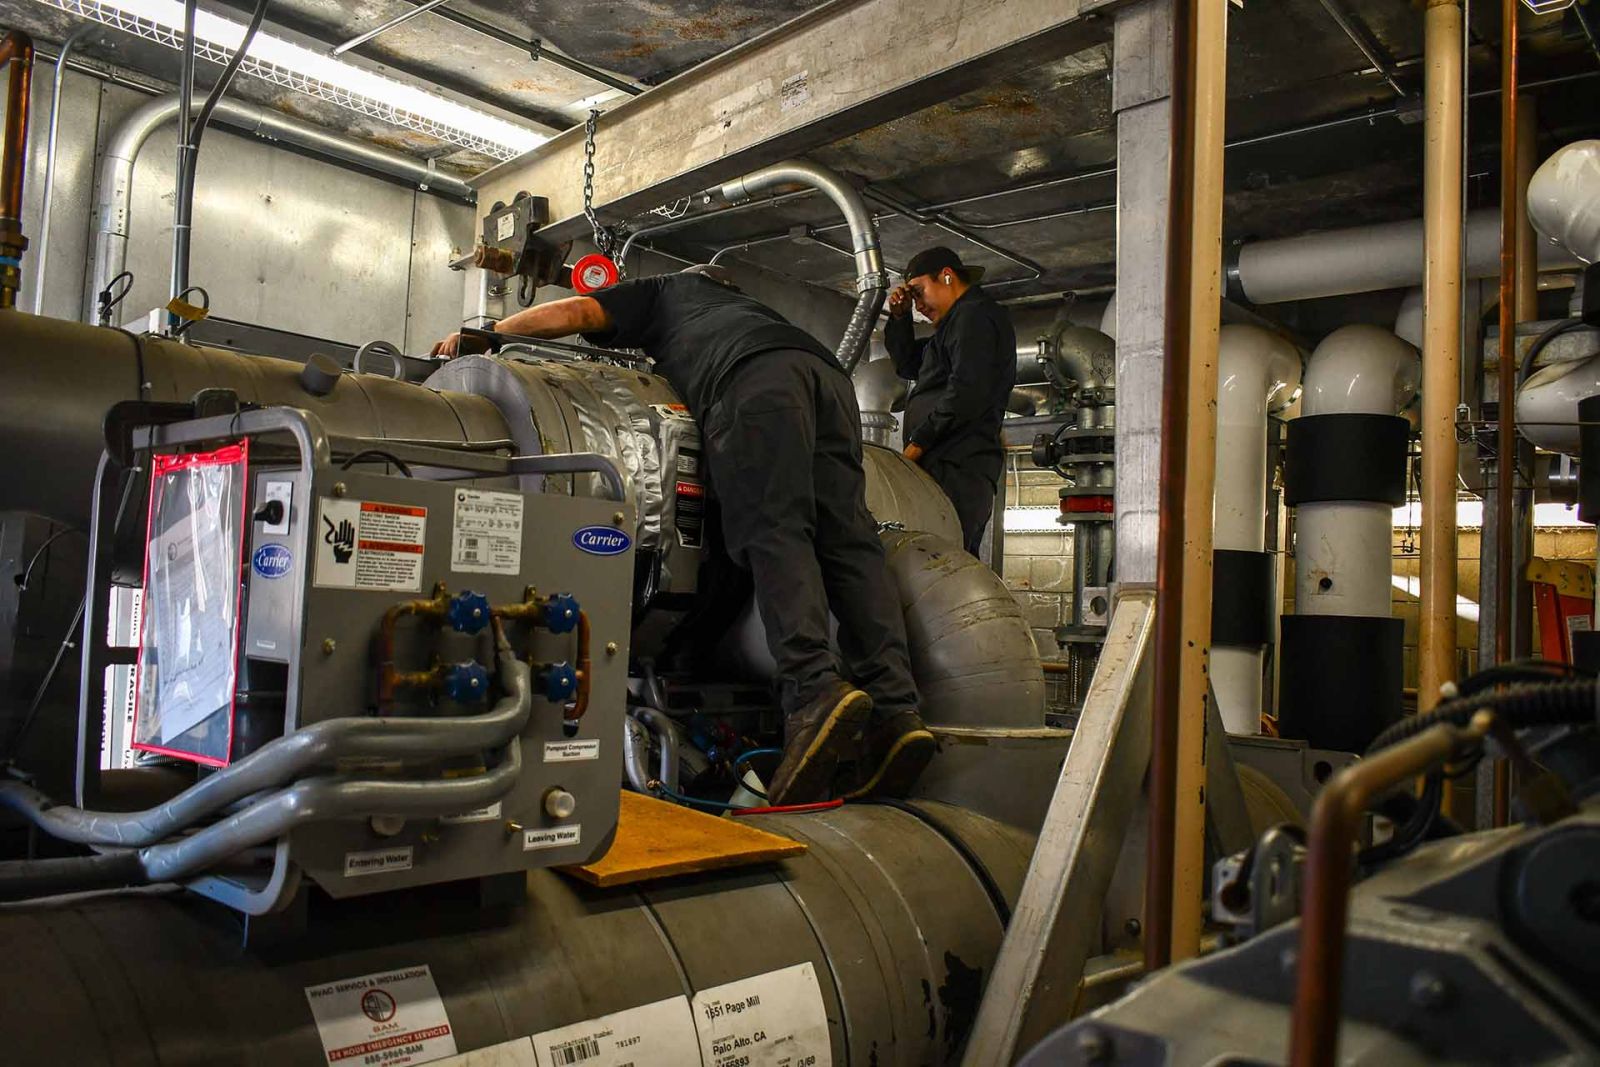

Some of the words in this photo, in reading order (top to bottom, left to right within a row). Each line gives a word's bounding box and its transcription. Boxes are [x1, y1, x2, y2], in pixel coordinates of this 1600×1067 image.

[581, 531, 624, 547] Carrier
[258, 549, 289, 569] Carrier
[132, 593, 140, 637] Chains
[528, 833, 556, 843] Leaving
[556, 831, 576, 839] Water
[349, 856, 385, 868] Entering
[385, 854, 409, 863] Water
[310, 986, 334, 997] HVAC
[335, 980, 368, 993] SERVICE
[375, 969, 427, 985] INSTALLATION
[725, 1001, 746, 1014] Page
[745, 995, 761, 1008] Mill
[329, 1050, 342, 1060] 24
[342, 1045, 366, 1057] HOUR
[366, 1034, 413, 1051] EMERGENCY
[413, 1026, 449, 1041] SERVICES
[713, 1043, 732, 1056] Palo
[733, 1037, 753, 1050] Alto,
[753, 1031, 767, 1042] CA
